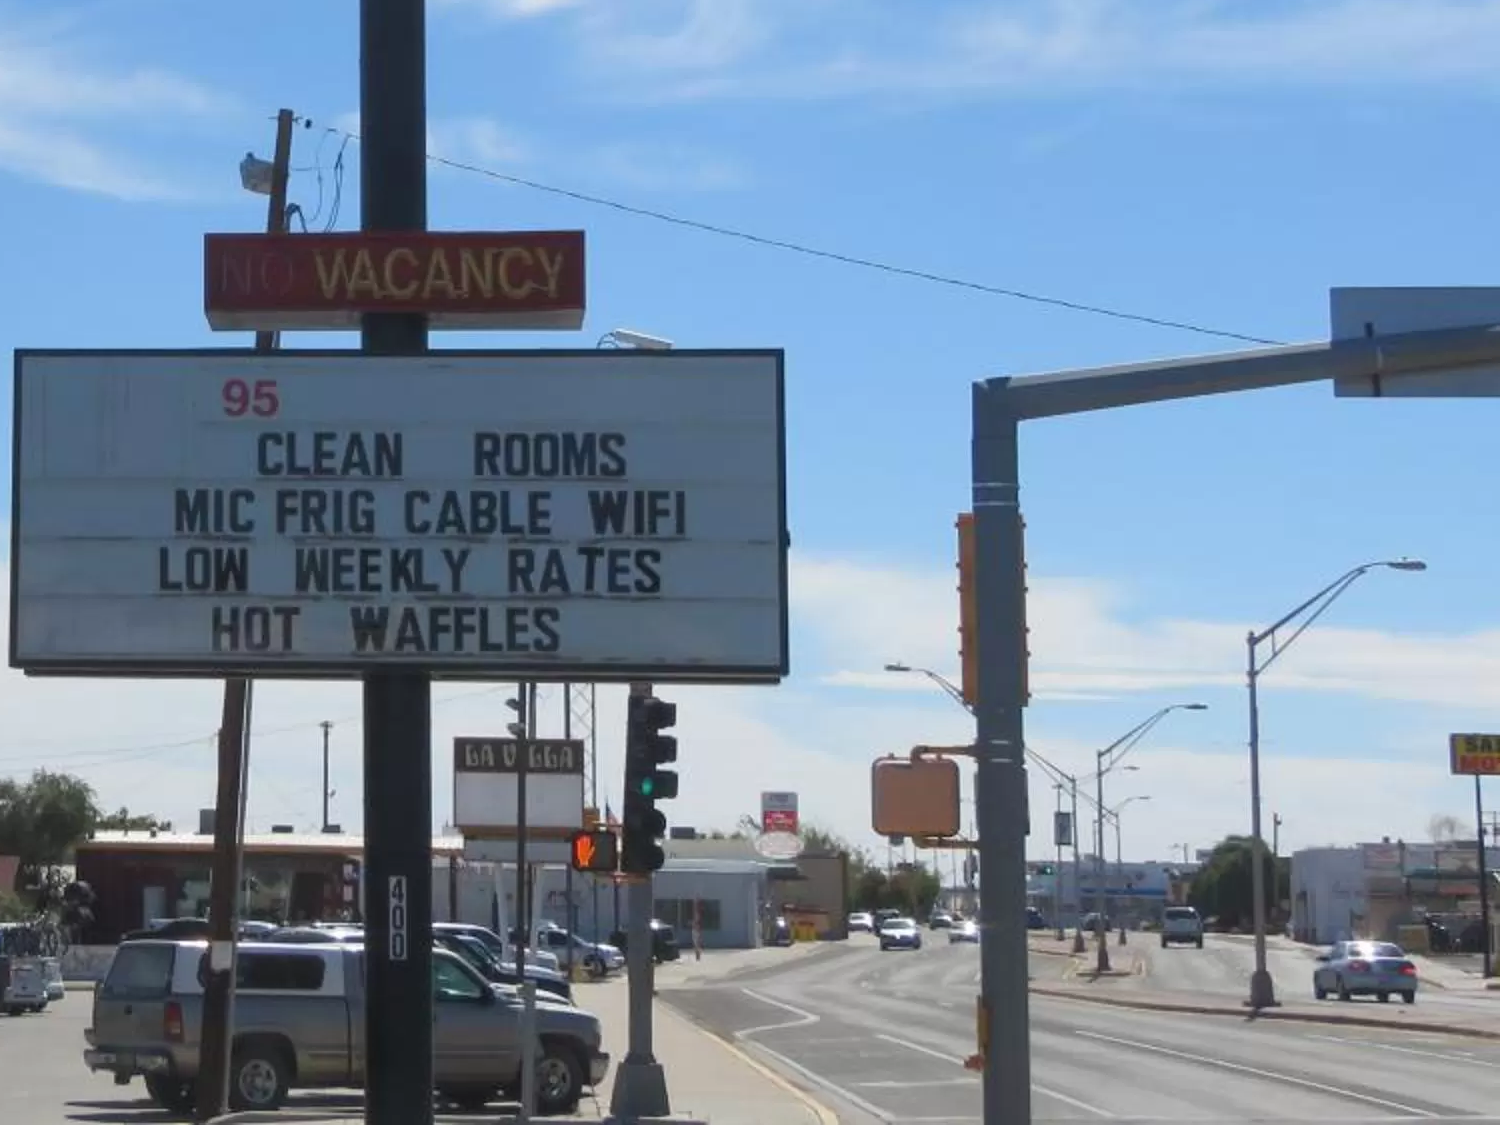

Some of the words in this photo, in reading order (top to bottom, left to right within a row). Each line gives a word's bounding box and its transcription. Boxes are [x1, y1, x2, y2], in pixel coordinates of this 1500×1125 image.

[220, 249, 296, 298] NO
[313, 246, 565, 300] VACANCY
[221, 379, 280, 418] 95
[257, 431, 404, 477] CLEAN
[474, 432, 627, 477] ROOMS
[174, 489, 256, 533] MIC
[276, 489, 376, 534] FRIG
[404, 490, 552, 535] CABLE
[588, 490, 686, 535] WIFI
[159, 547, 249, 592] LOW
[295, 547, 471, 593] WEEKLY
[508, 546, 661, 594] RATES
[211, 606, 302, 652] HOT
[350, 606, 561, 653] WAFFLES
[502, 743, 574, 769] VLLA
[391, 878, 405, 958] 400
